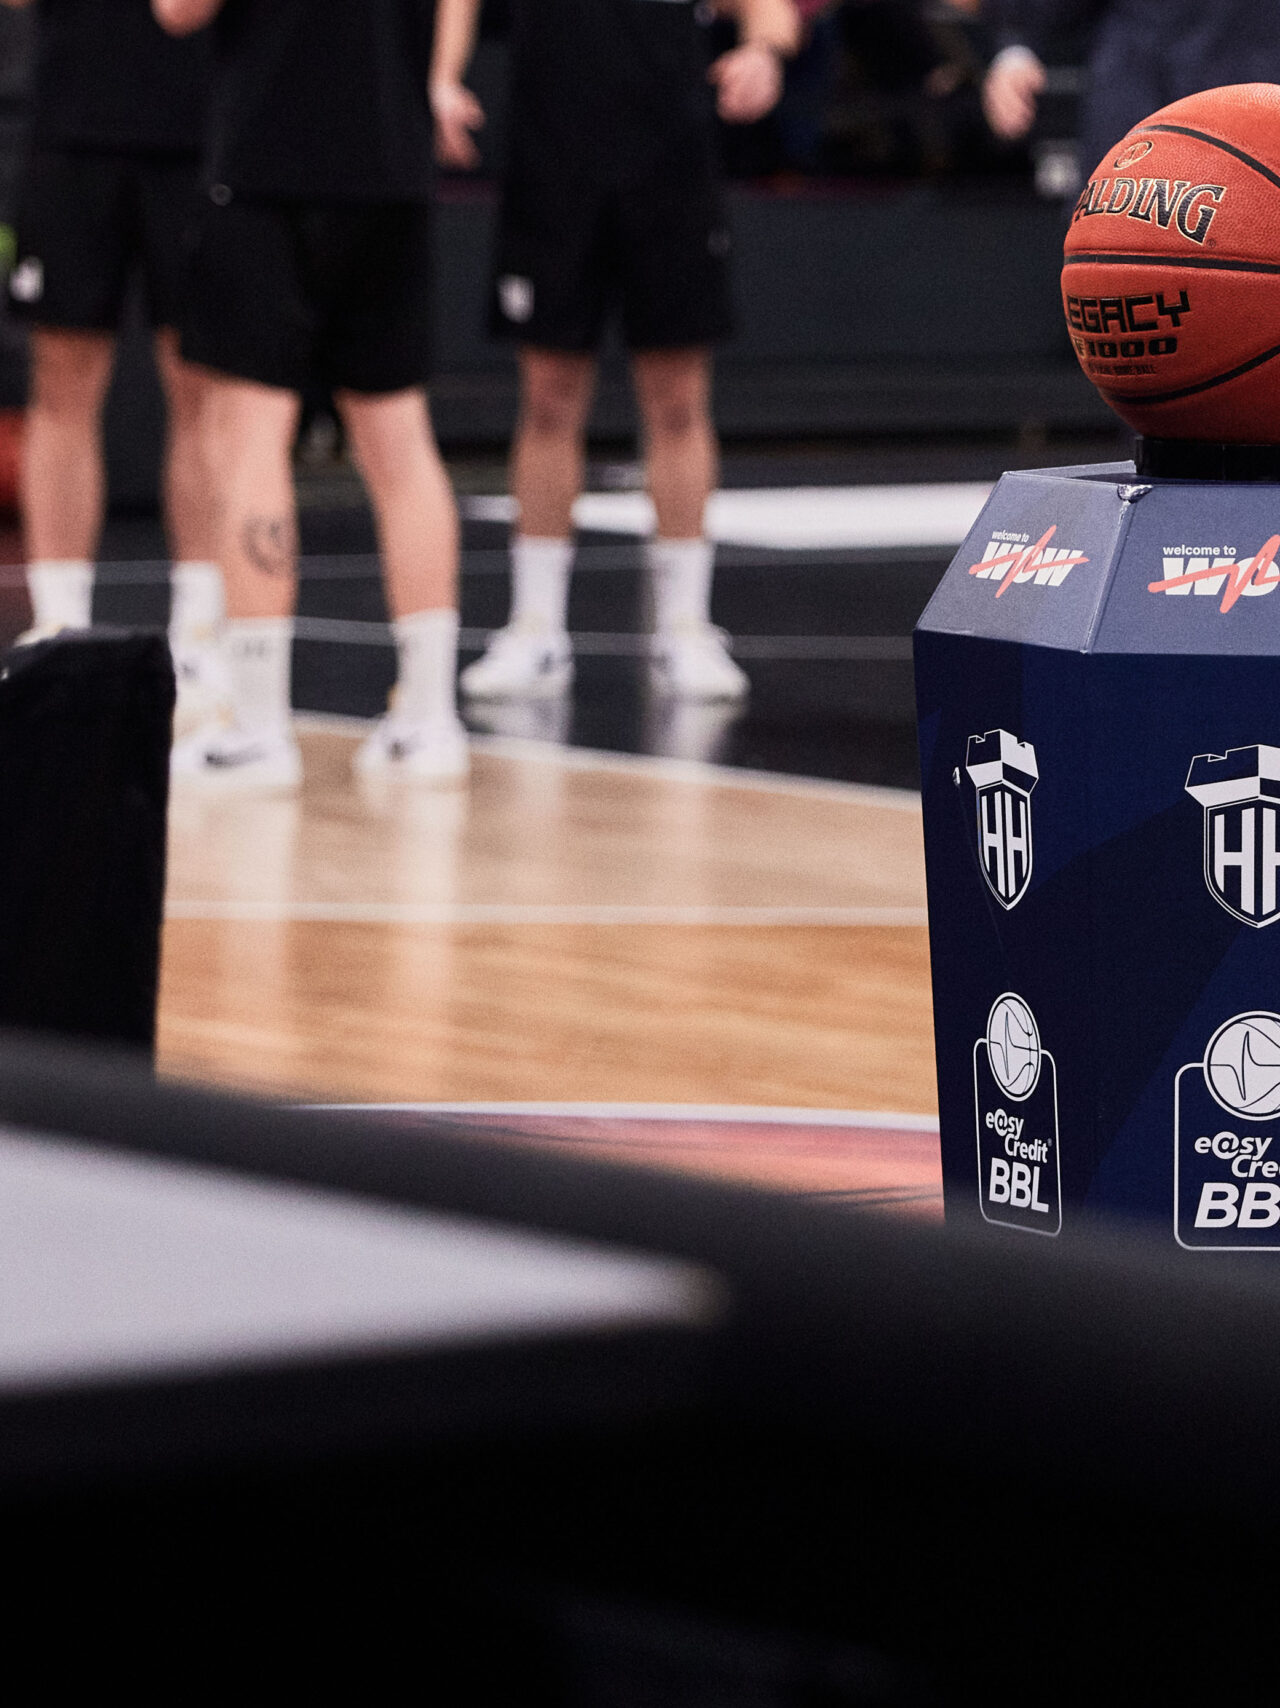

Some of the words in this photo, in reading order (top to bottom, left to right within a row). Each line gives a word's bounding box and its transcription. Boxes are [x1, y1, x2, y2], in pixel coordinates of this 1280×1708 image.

[1074, 177, 1227, 246] ALDING
[1065, 290, 1191, 334] EGACY
[991, 530, 1021, 542] welcome
[1021, 532, 1030, 543] to
[1162, 544, 1221, 556] welcome
[1223, 545, 1237, 556] to
[975, 541, 1084, 587] WOW
[981, 790, 1028, 898] HH
[989, 1157, 1049, 1213] BBL
